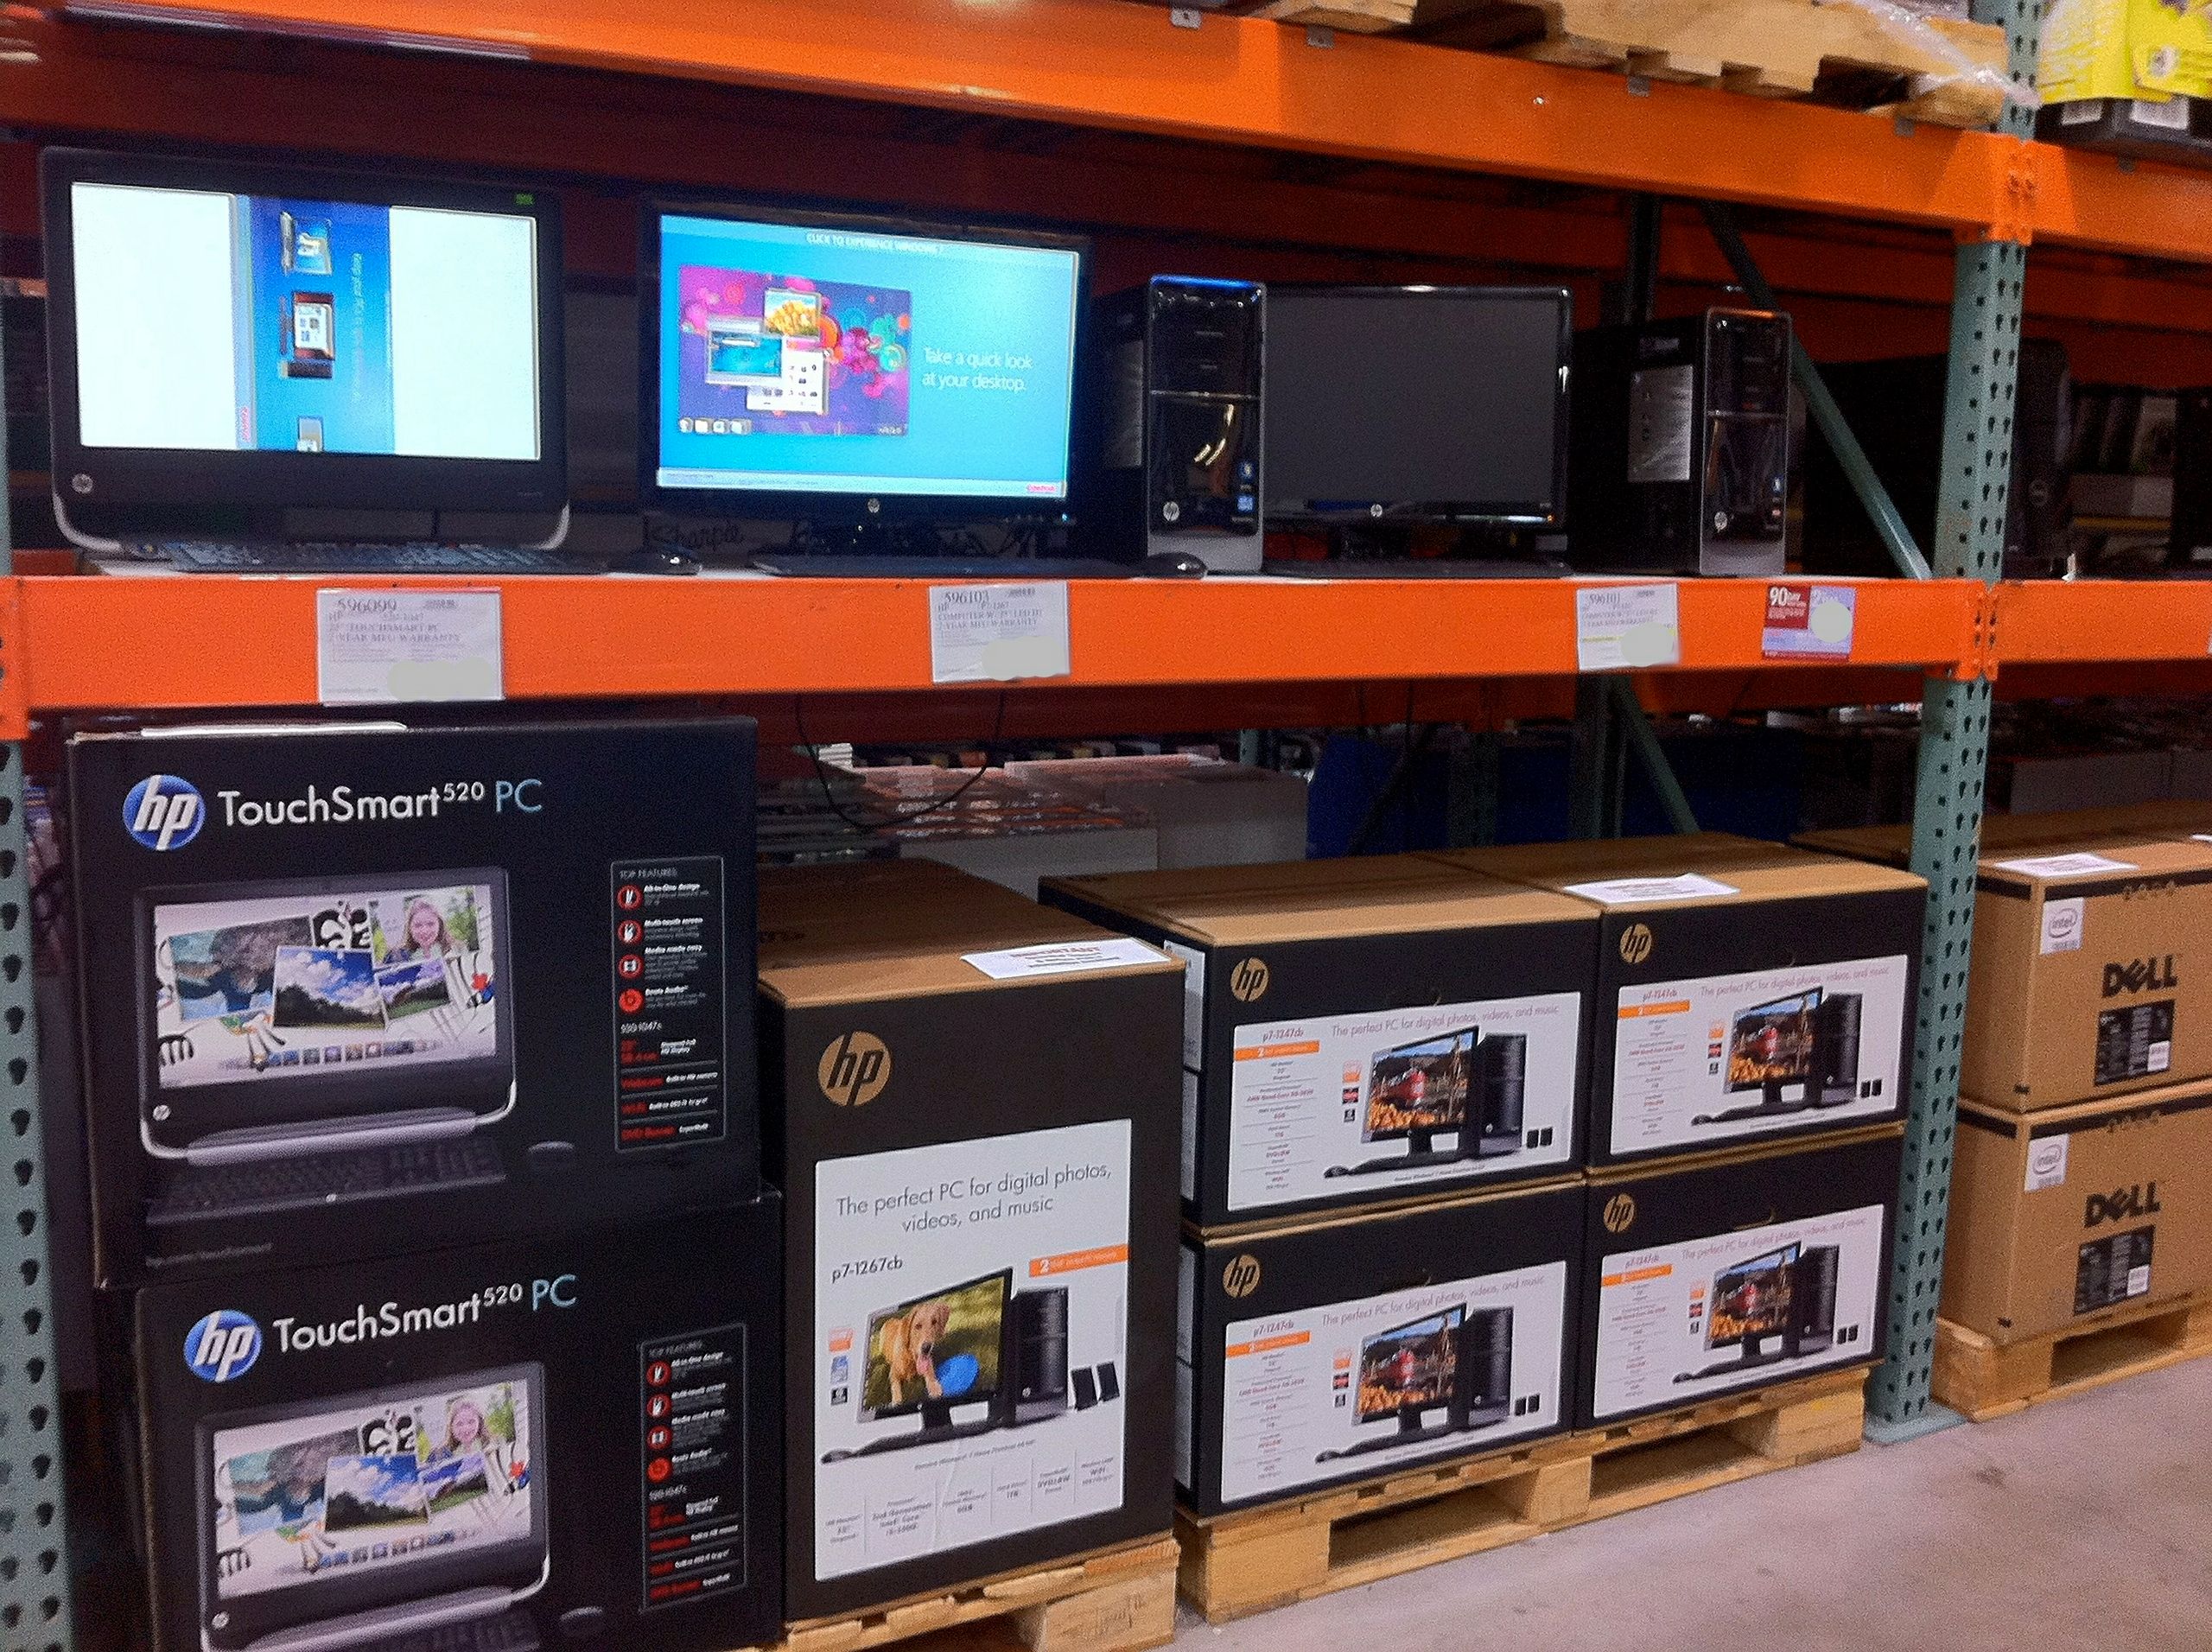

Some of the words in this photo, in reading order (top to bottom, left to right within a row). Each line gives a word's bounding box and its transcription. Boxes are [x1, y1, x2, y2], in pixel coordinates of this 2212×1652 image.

[922, 370, 936, 387] at
[938, 373, 969, 393] your
[924, 346, 953, 366] Take
[955, 353, 964, 366] a
[966, 348, 1001, 374] quick
[1004, 352, 1033, 370] look
[1770, 586, 1789, 607] 90
[130, 775, 195, 850] hp
[217, 785, 441, 828] TouchSmart
[442, 780, 486, 804] 520
[495, 778, 543, 815] PC
[1621, 923, 1650, 964] hp
[1233, 956, 1268, 1002] hp
[2101, 954, 2178, 999] DELL
[1332, 1024, 1348, 1038] The
[1351, 1020, 1383, 1038] perfect
[1385, 1018, 1400, 1032] PC
[1401, 1018, 1414, 1030] for
[1414, 1013, 1445, 1030] digital
[1515, 1005, 1533, 1018] and
[827, 1031, 887, 1107] hp
[836, 1196, 868, 1217] The
[874, 1185, 934, 1221] perfect
[939, 1179, 965, 1202] PC
[969, 1176, 992, 1196] for
[997, 1166, 1050, 1196] digital
[1053, 1162, 1113, 1190] photos,
[1605, 1193, 1635, 1233] hp
[2084, 1180, 2163, 1229] DELL
[901, 1210, 963, 1234] videos,
[968, 1199, 1001, 1223] and
[1007, 1195, 1055, 1217] music
[831, 1254, 904, 1284] p7-1267cb
[1039, 1258, 1051, 1274] 2
[1224, 1254, 1259, 1297] hp
[273, 1294, 481, 1356] TouchSmart
[483, 1283, 523, 1307] 520
[532, 1274, 578, 1311] PC
[1322, 1313, 1339, 1327] The
[1341, 1306, 1373, 1326] perfect
[1375, 1303, 1389, 1316] PC
[1389, 1301, 1403, 1313] for
[1502, 1277, 1520, 1292] and
[192, 1309, 257, 1382] hp
